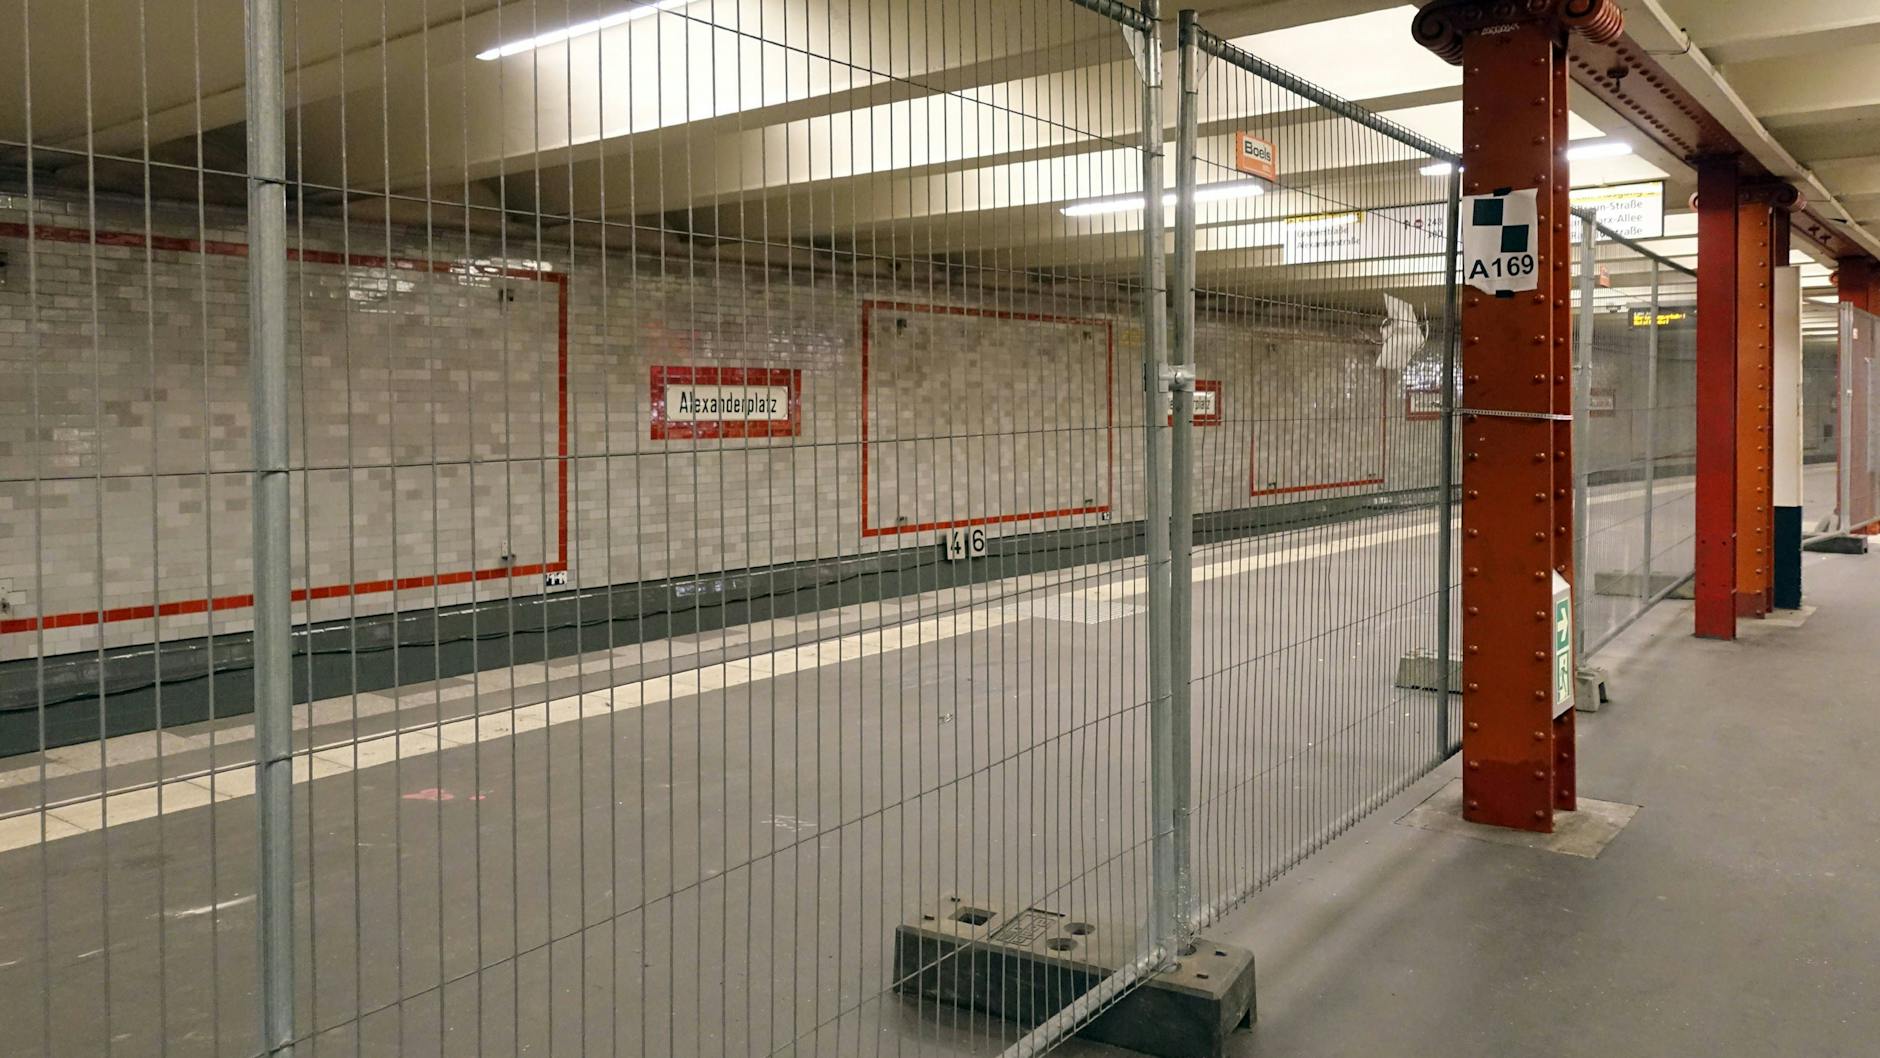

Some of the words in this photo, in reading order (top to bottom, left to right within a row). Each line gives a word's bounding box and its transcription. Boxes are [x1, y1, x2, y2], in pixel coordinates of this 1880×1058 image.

[1244, 140, 1271, 162] Boels
[1469, 254, 1534, 279] A169
[679, 391, 777, 415] Alexanderplatz
